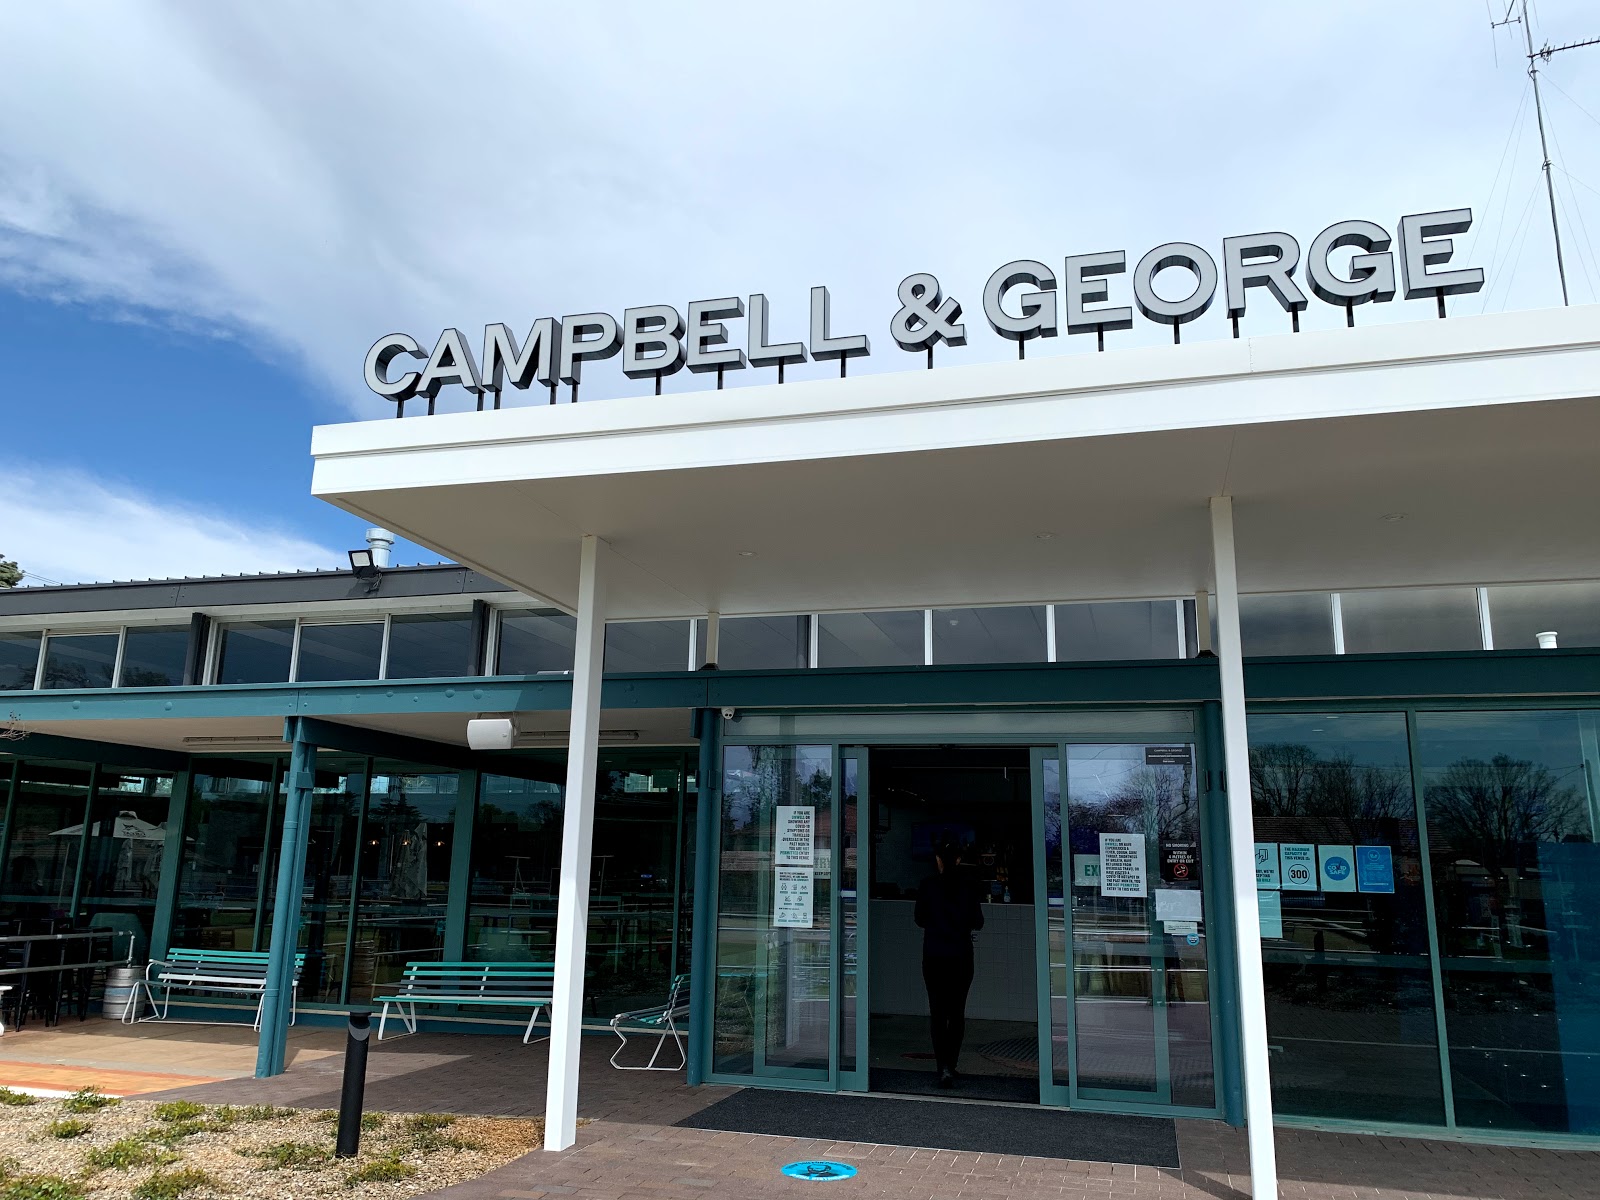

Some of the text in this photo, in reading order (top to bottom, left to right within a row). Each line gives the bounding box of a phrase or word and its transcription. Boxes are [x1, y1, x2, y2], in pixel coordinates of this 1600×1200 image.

[364, 208, 1485, 401] CAMPBELL & GEORGE
[1084, 865, 1101, 876] EXI
[1291, 870, 1307, 878] 300
